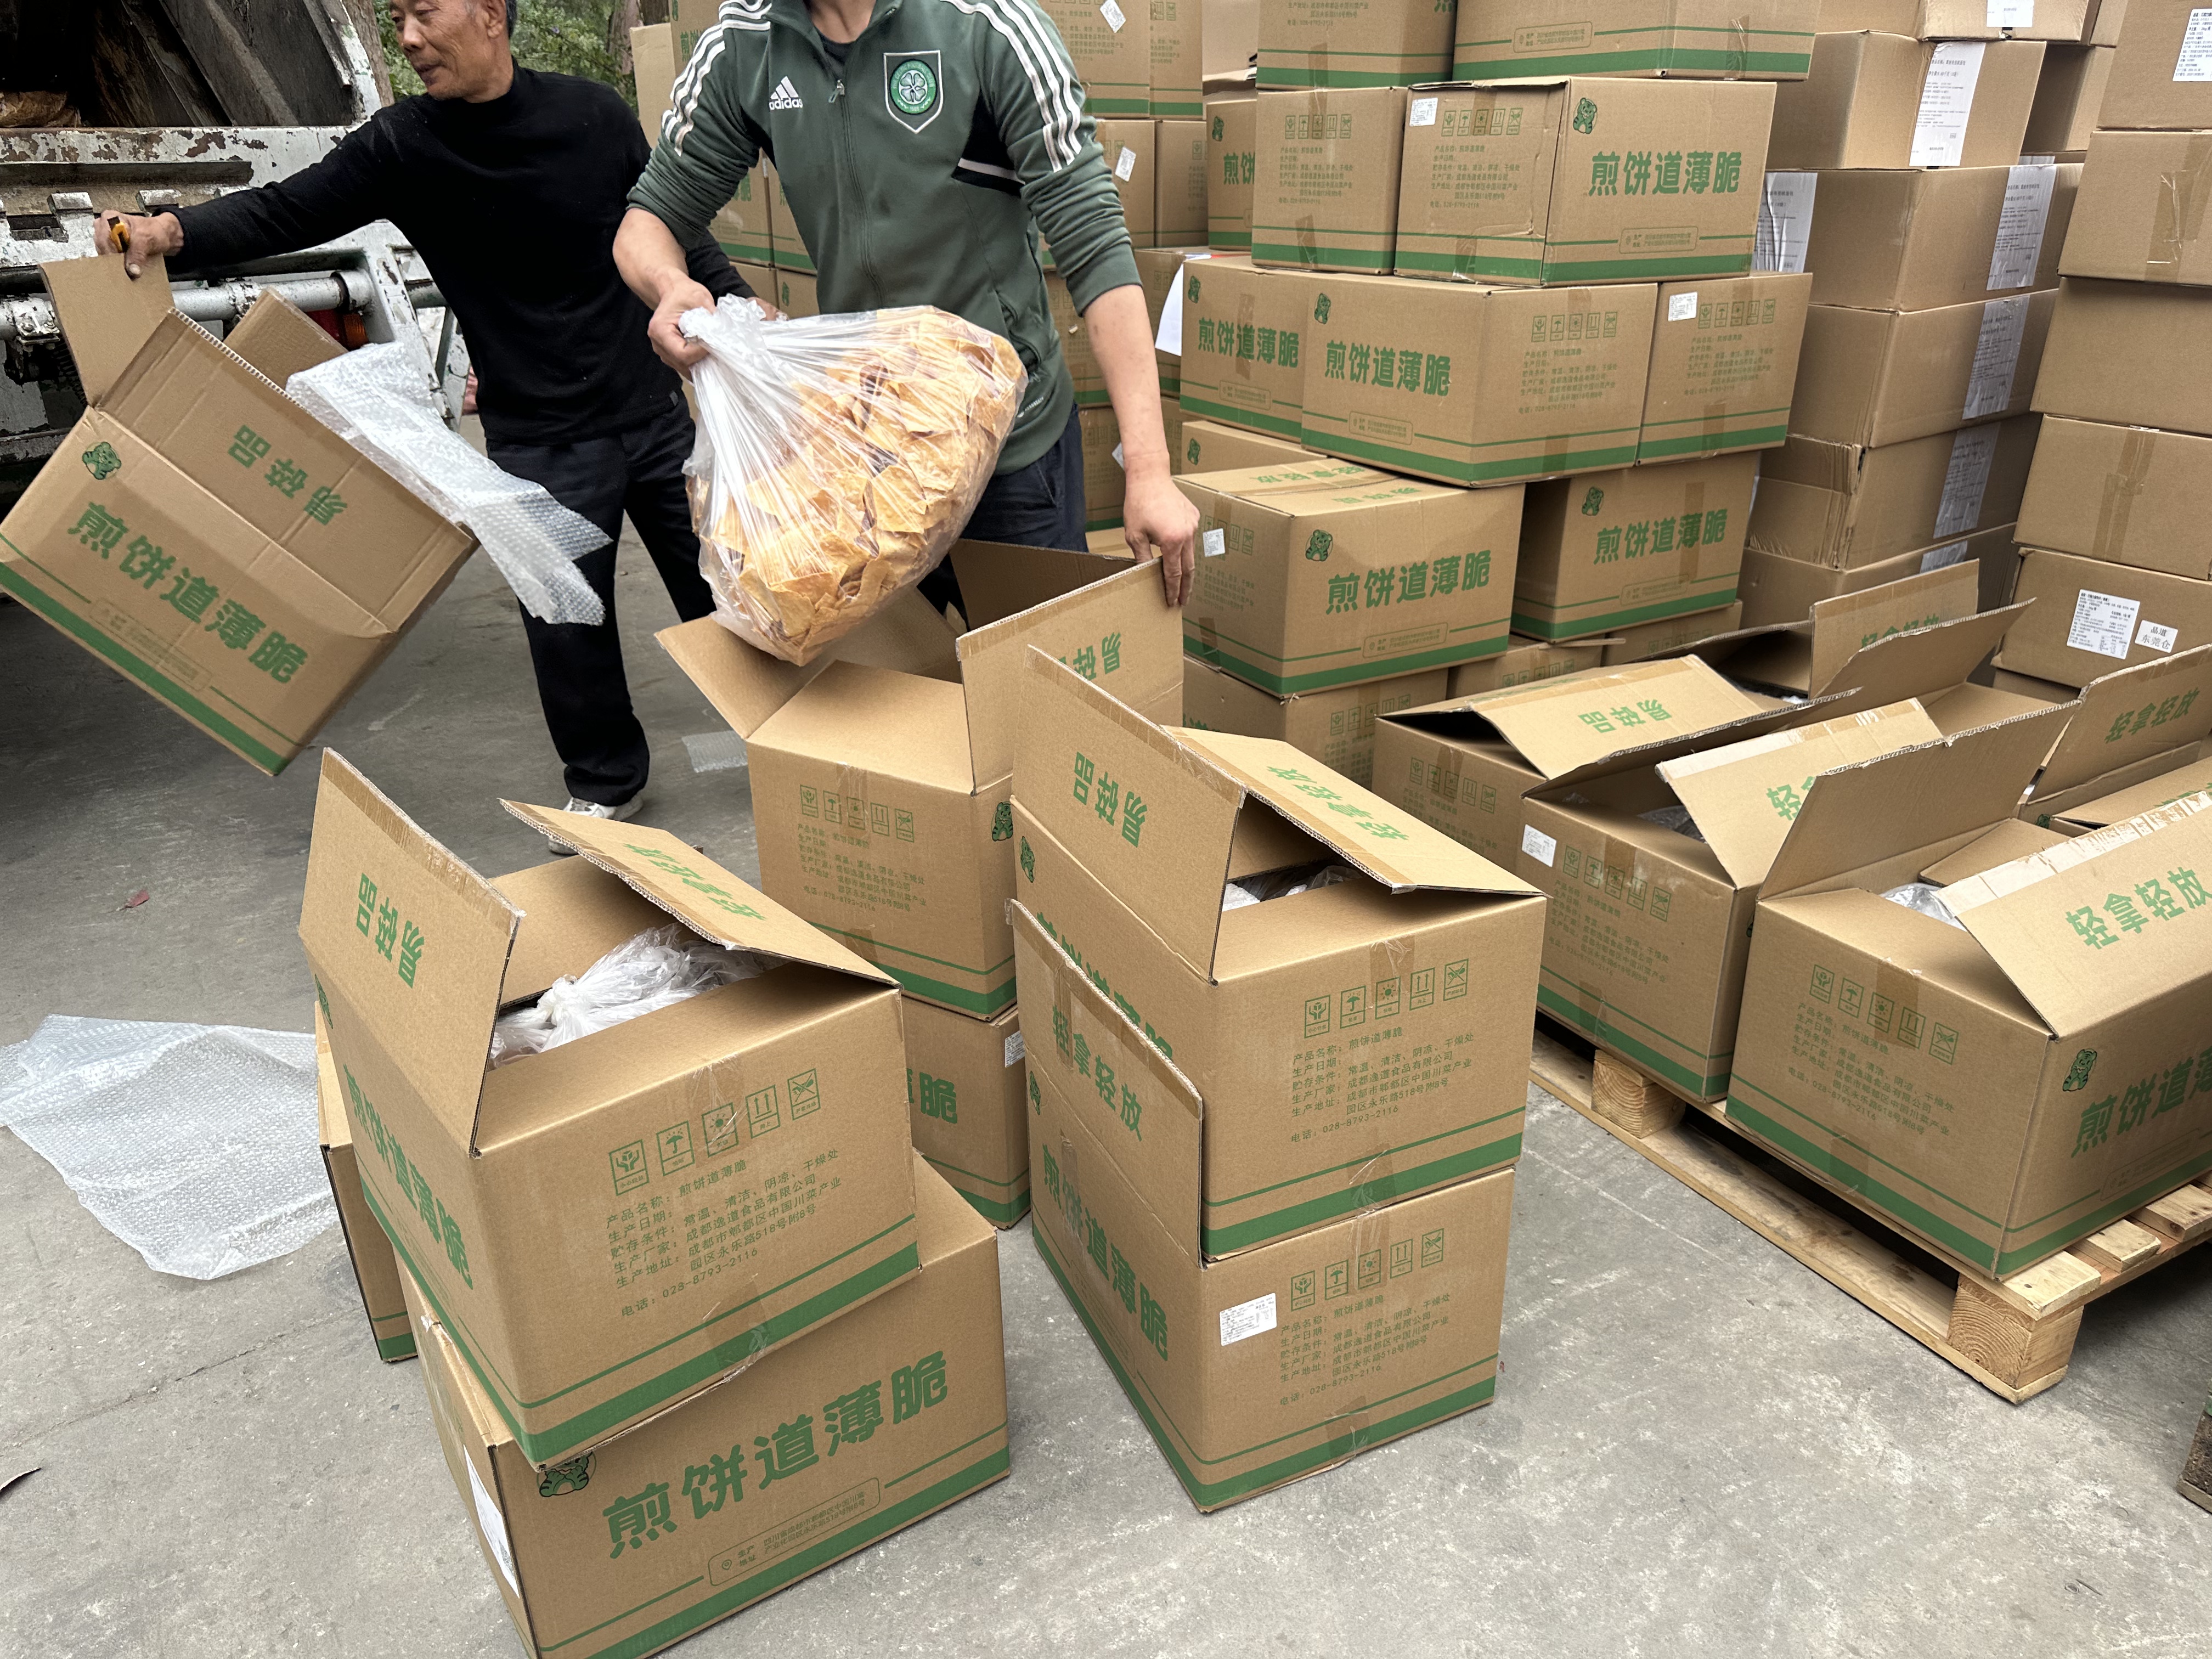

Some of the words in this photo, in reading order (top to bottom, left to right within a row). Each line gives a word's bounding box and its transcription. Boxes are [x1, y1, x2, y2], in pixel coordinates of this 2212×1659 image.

[769, 98, 803, 110] adidas
[1588, 150, 1742, 196] 煎饼道薄脆
[1198, 317, 1300, 368] 煎饼道薄脆
[1324, 340, 1451, 397] 煎饼道薄脆
[228, 425, 348, 525] 易碎品
[1593, 509, 1727, 565] 煎饼道薄脆
[68, 501, 308, 684] 煎饼道薄脆
[1325, 550, 1491, 615] 煎饼道薄脆
[1059, 632, 1121, 681] 易碎
[1578, 699, 1672, 734] 易碎品
[2104, 687, 2200, 744] 轻拿轻放
[1073, 751, 1148, 848] 易碎品
[1766, 776, 1816, 821] 轻
[356, 873, 425, 988] 易碎品
[2065, 867, 2212, 950] 轻拿轻放
[1052, 1005, 1142, 1141] 轻拿轻放
[1292, 1058, 1341, 1078] 生产日期：
[1293, 1026, 1403, 1065] 产品名称：煎饼道薄脆
[906, 1068, 958, 1124] 脆
[1291, 1105, 1399, 1143] 电话：028-8793-2116
[1346, 1077, 1449, 1115] 园区永乐路518号附8号
[606, 1159, 747, 1229] 产品名称：煎饼道薄脆
[611, 1148, 839, 1261] 贮存条件：常温、清洁、阴凉、干燥处
[608, 1210, 673, 1244] 生产日期：
[613, 1173, 816, 1274] 生产厂家：成都逸道食品有限公司
[616, 1176, 842, 1289] 生产地址：成都市郫都区中国川菜产业
[690, 1203, 817, 1272] 园区永乐路518号附8号
[1042, 1143, 1168, 1361] 煎饼道薄脆
[621, 1248, 759, 1317] 电话：028-8793-2116
[1280, 1294, 1384, 1336] 产品名称：煎饼道薄脆
[1279, 1363, 1382, 1406] 电话：028-8793-2116
[602, 1350, 948, 1560] 煎饼道薄脆
